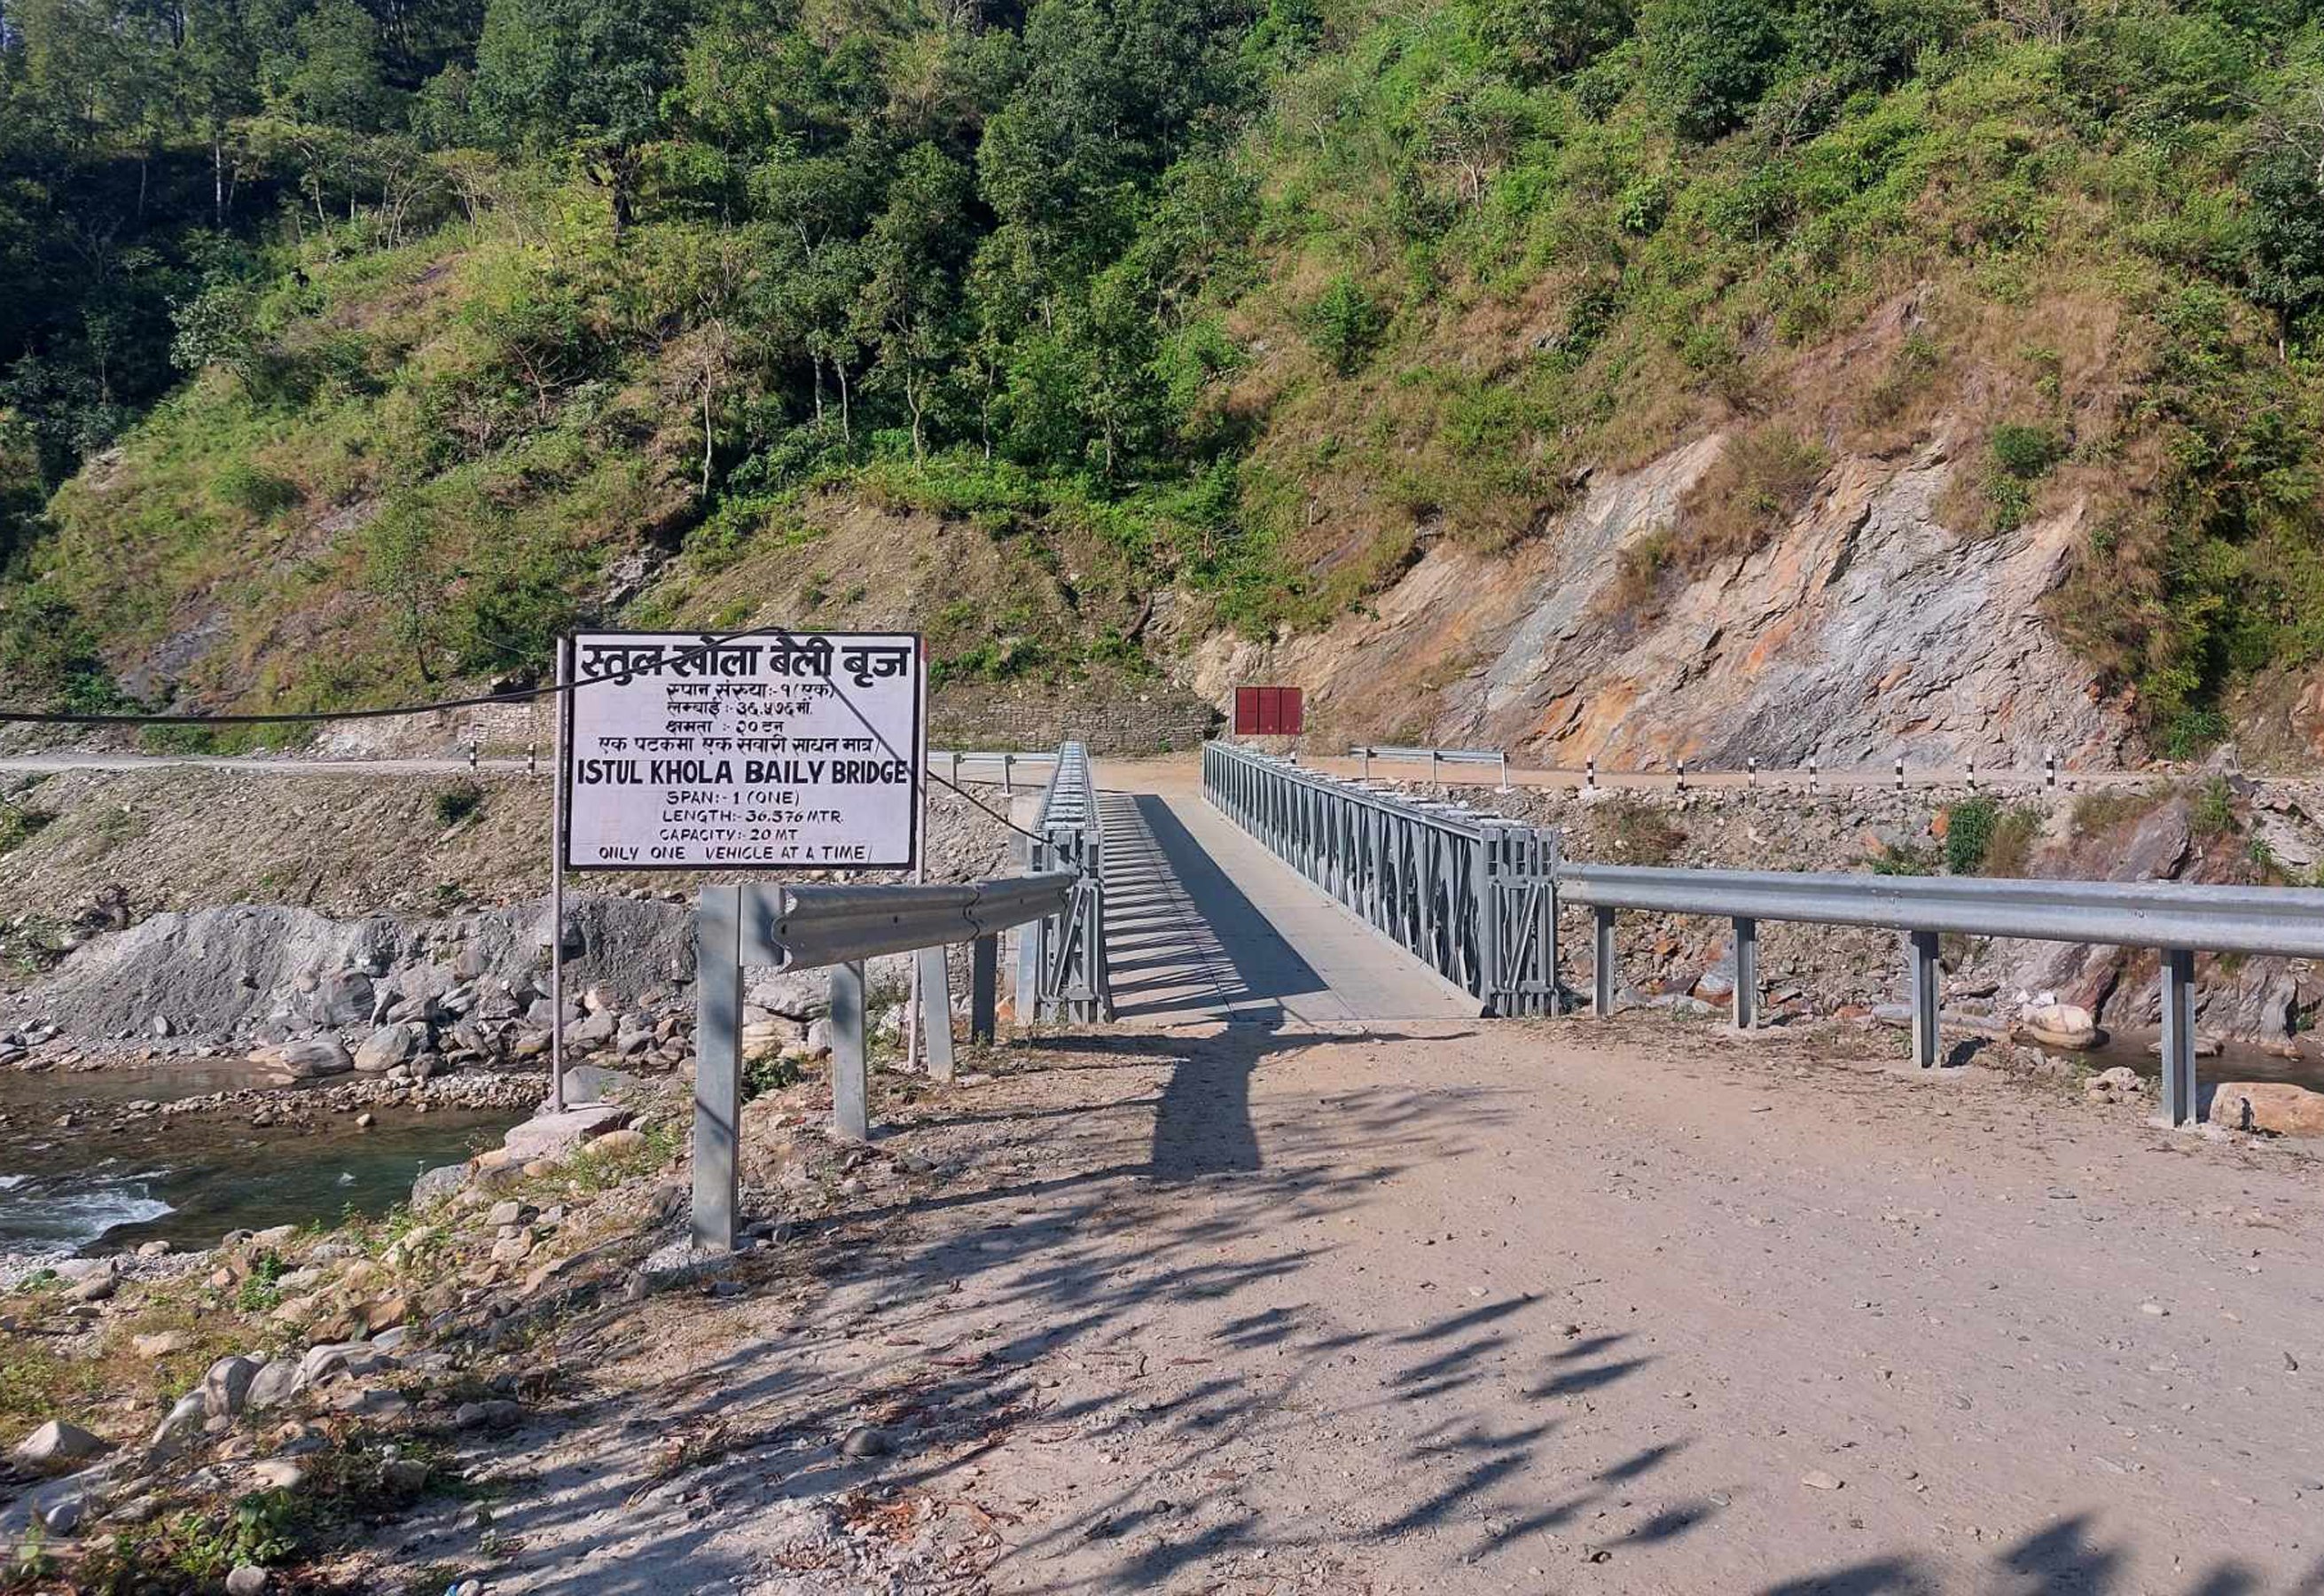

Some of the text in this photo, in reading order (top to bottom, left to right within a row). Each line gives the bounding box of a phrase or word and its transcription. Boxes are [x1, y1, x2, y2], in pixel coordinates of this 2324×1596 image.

[670, 636, 763, 677] खोला
[841, 646, 912, 688] बृज
[666, 720, 713, 736] क्षमता
[735, 720, 758, 736] २०
[762, 721, 785, 732] टन
[599, 737, 628, 754] एक
[634, 737, 694, 751] पटकमा
[702, 737, 732, 755] एक
[737, 734, 787, 756] सवारी
[792, 738, 839, 755] साधन
[577, 759, 908, 785] ISTUL KHOLA BAILY BRIDGE
[747, 790, 800, 806] (ONE)
[745, 810, 803, 824] 36.576
[750, 828, 771, 841] 20
[775, 829, 798, 841] MT
[650, 847, 686, 860] ONE
[706, 846, 773, 860] VEHICLE
[781, 847, 799, 859] AT
[805, 847, 814, 859] A
